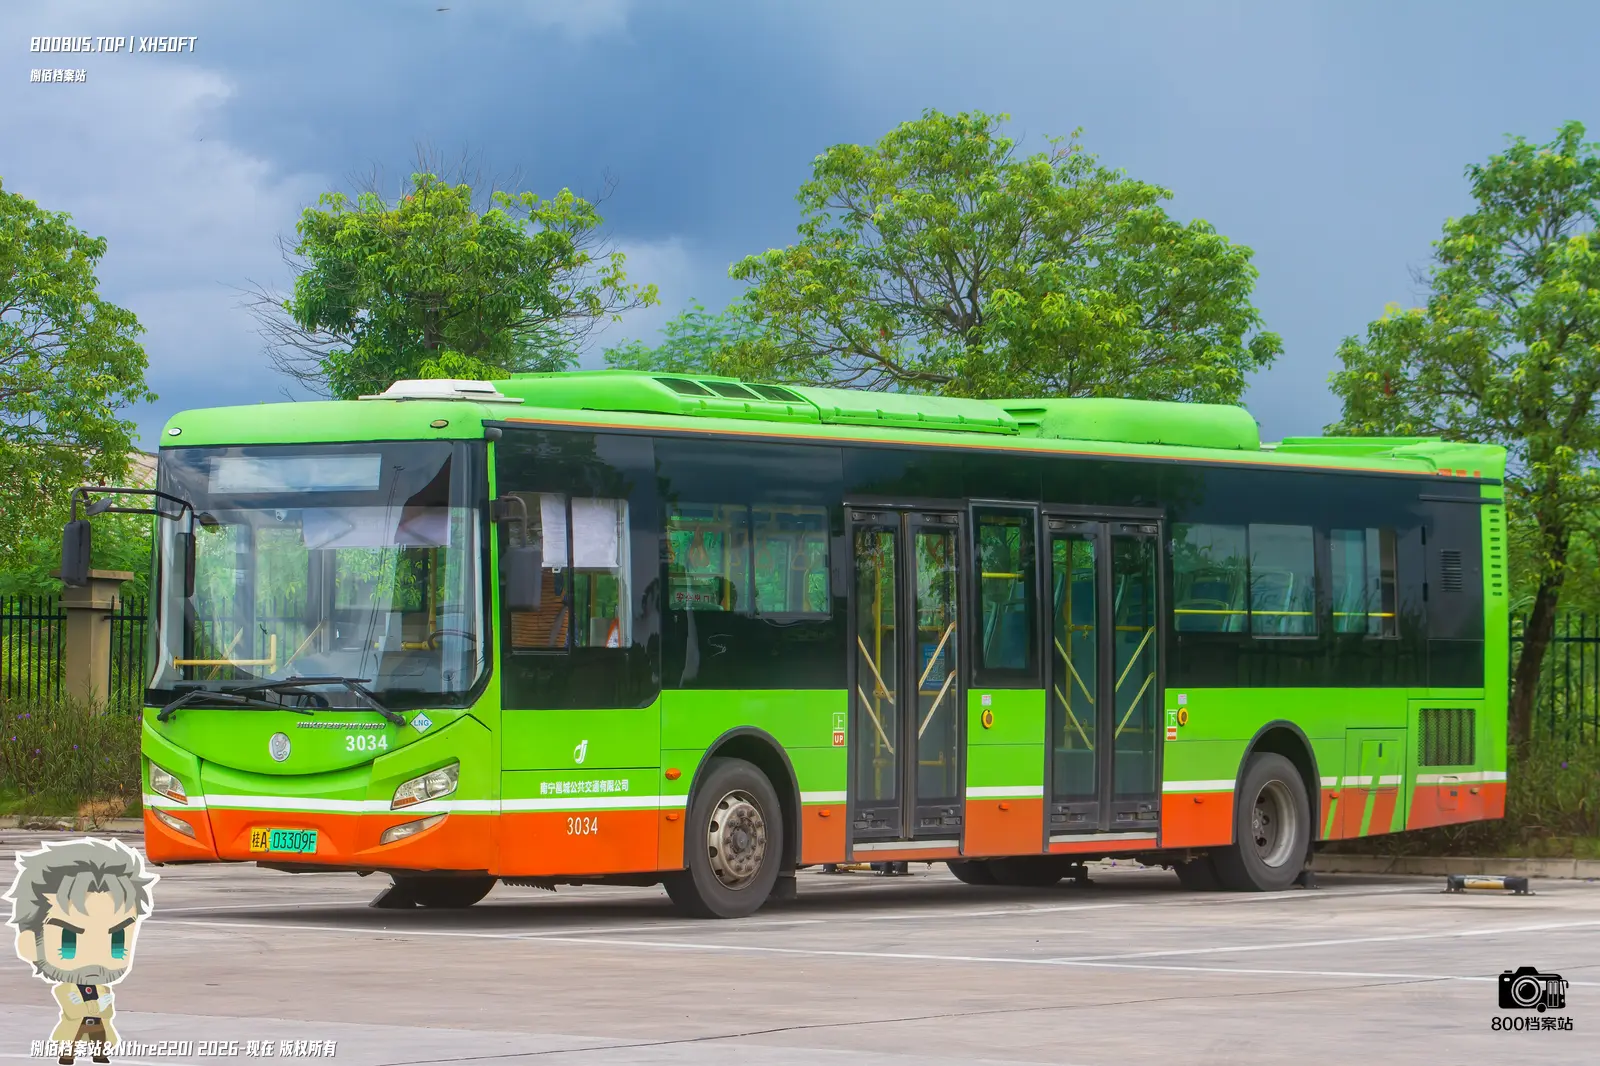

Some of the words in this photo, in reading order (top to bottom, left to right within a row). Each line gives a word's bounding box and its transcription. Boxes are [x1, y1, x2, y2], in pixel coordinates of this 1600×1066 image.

[413, 718, 430, 727] LNG
[345, 734, 389, 752] 3034
[834, 734, 844, 744] UP
[540, 779, 629, 796] 南宁邕城公共交通有限公司
[566, 816, 598, 836] 3034
